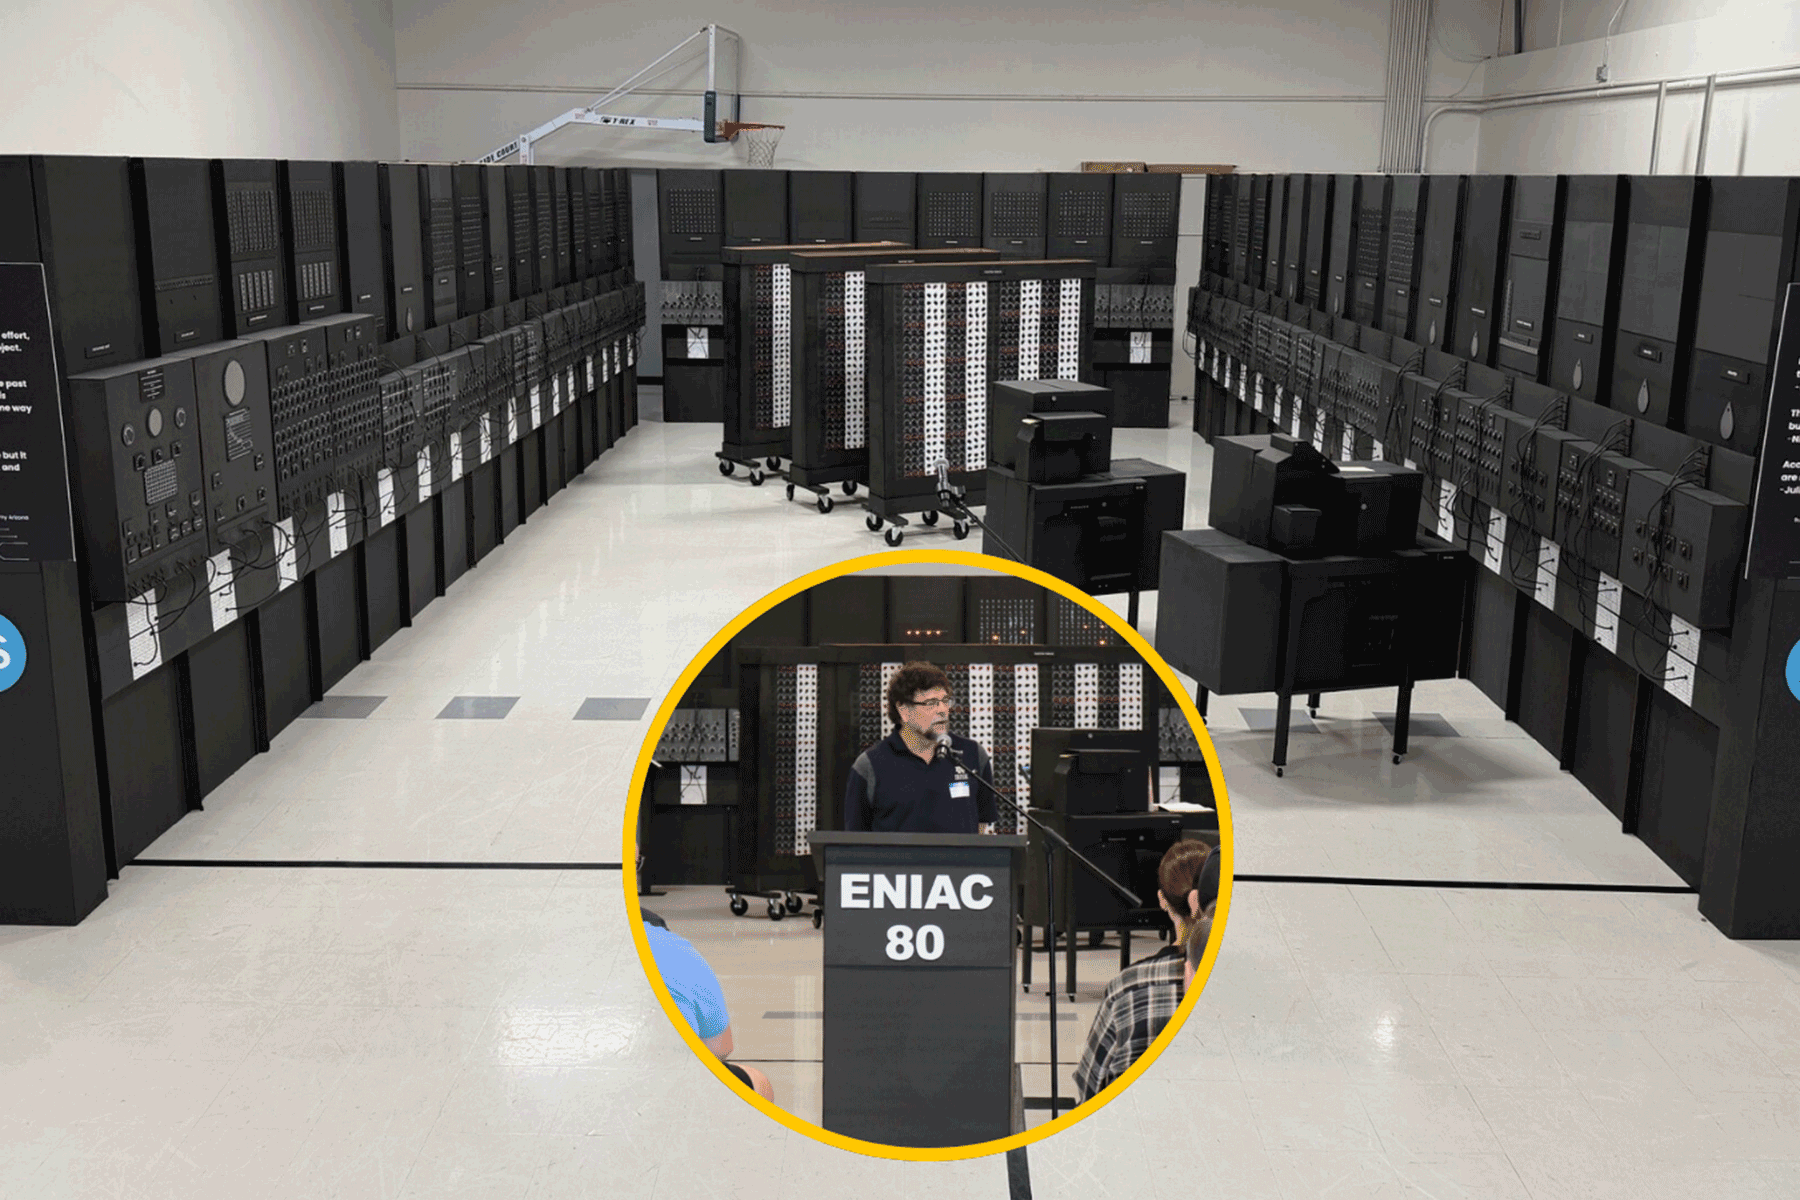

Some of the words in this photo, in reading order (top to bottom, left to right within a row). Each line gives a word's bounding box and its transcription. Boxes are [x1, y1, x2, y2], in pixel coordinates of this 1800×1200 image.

[1, 331, 30, 340] effort,
[0, 343, 22, 354] ject.
[5, 380, 27, 390] past
[11, 405, 32, 414] way
[2, 451, 19, 459] but
[1, 463, 20, 471] and
[841, 873, 994, 910] ENIAC
[886, 924, 945, 961] 80
